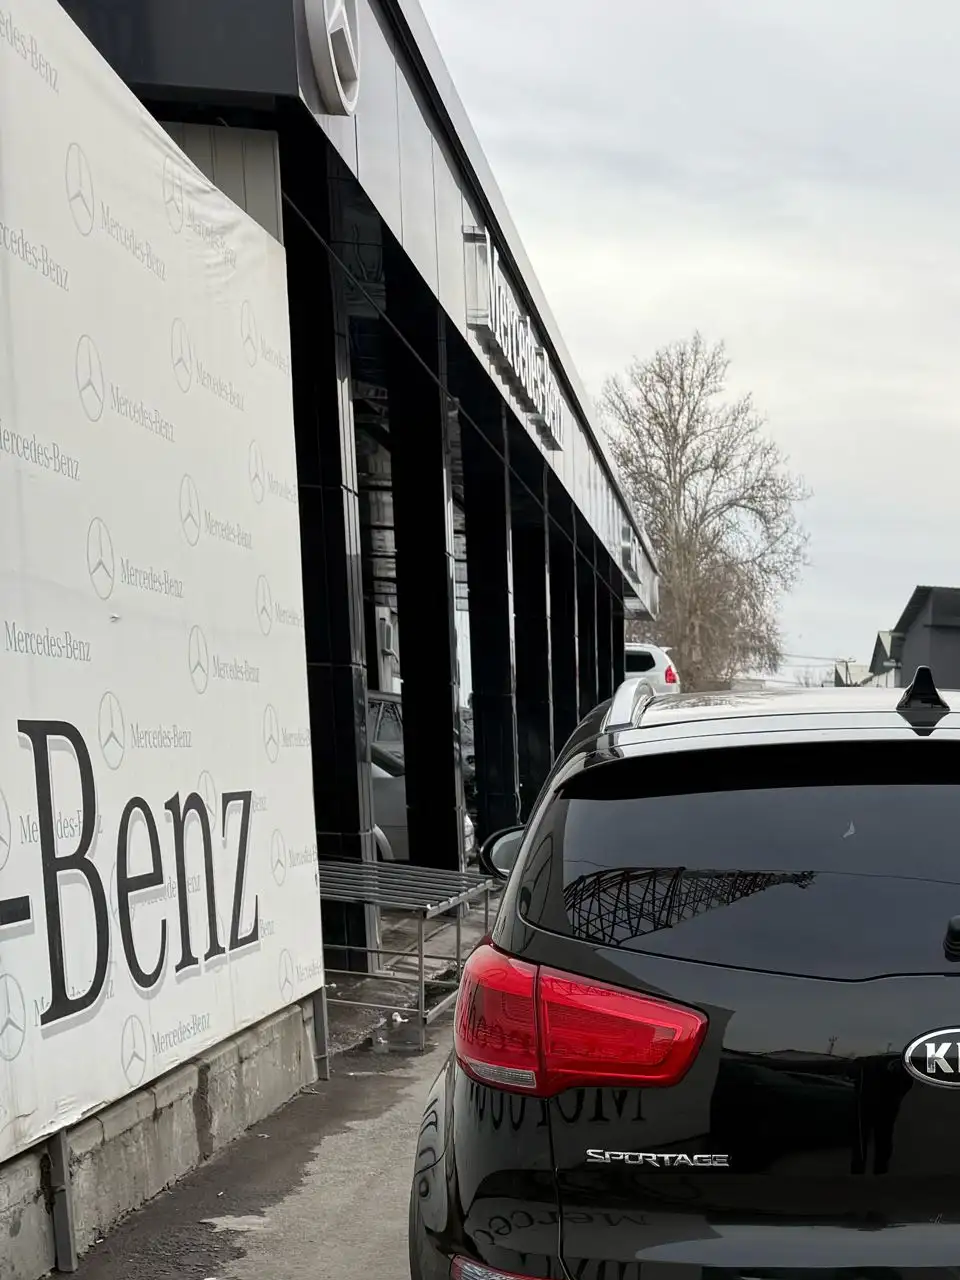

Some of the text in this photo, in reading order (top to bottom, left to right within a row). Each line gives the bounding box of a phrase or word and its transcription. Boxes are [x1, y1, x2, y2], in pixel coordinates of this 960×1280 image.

[0, 418, 80, 481] ercedes-Benz
[120, 556, 184, 599] Mercedes-Benz
[4, 619, 92, 662] Mercedes-Benz
[130, 721, 192, 749] Mercedes-Benz
[152, 1012, 212, 1056] Mercedes-Benz
[586, 1149, 729, 1167] SPORTAGE
